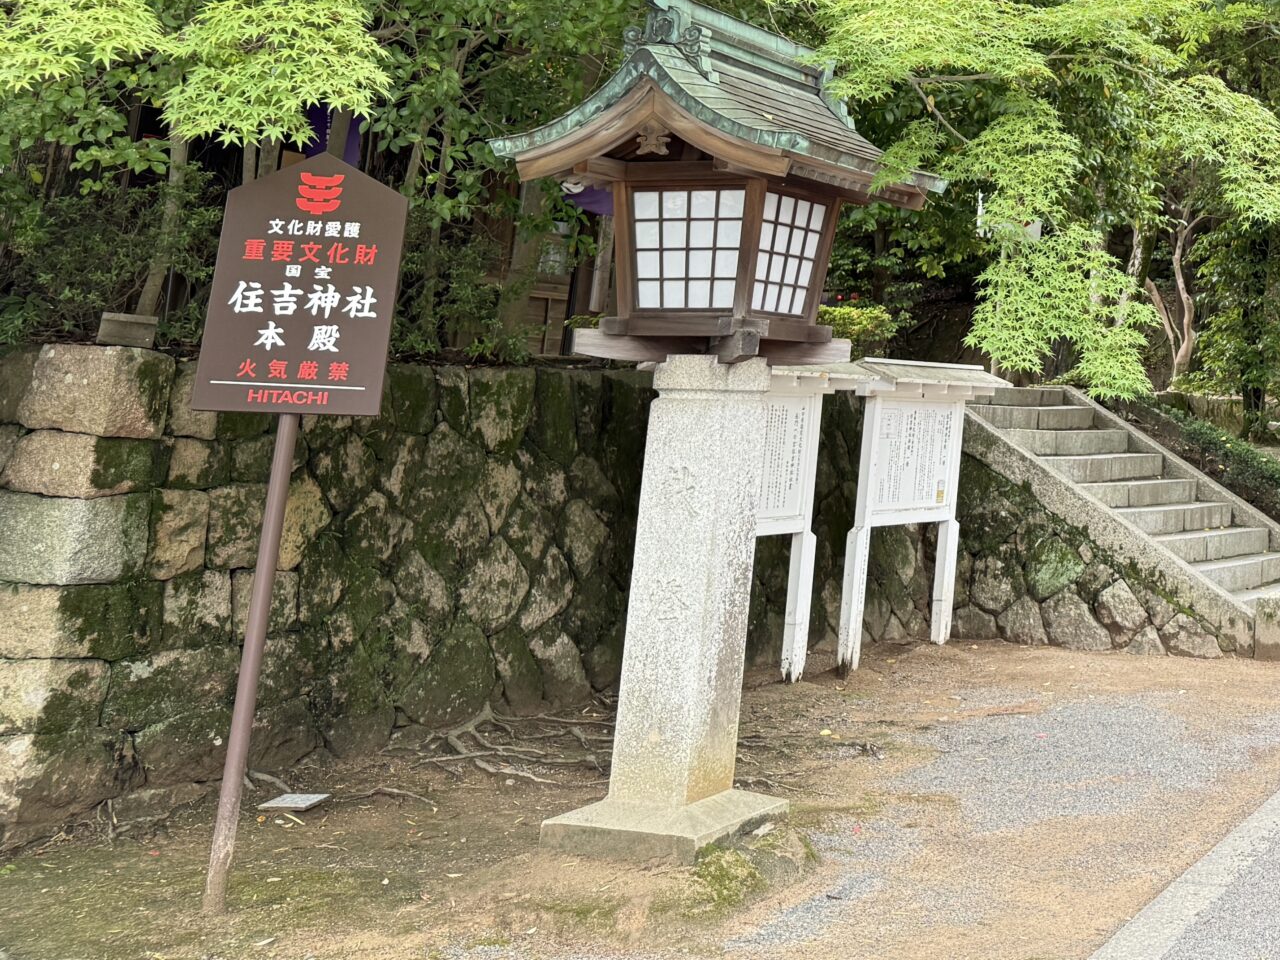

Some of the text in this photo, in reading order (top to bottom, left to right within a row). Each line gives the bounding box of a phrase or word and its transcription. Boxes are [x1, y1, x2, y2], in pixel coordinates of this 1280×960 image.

[267, 218, 361, 239] 文化財愛護
[242, 239, 378, 265] 重要文化財
[285, 264, 333, 280] 国宝
[228, 280, 378, 319] 住吉神社
[253, 321, 341, 352] 本殿
[236, 358, 350, 381] 火気厳禁
[247, 389, 329, 406] HITACHI
